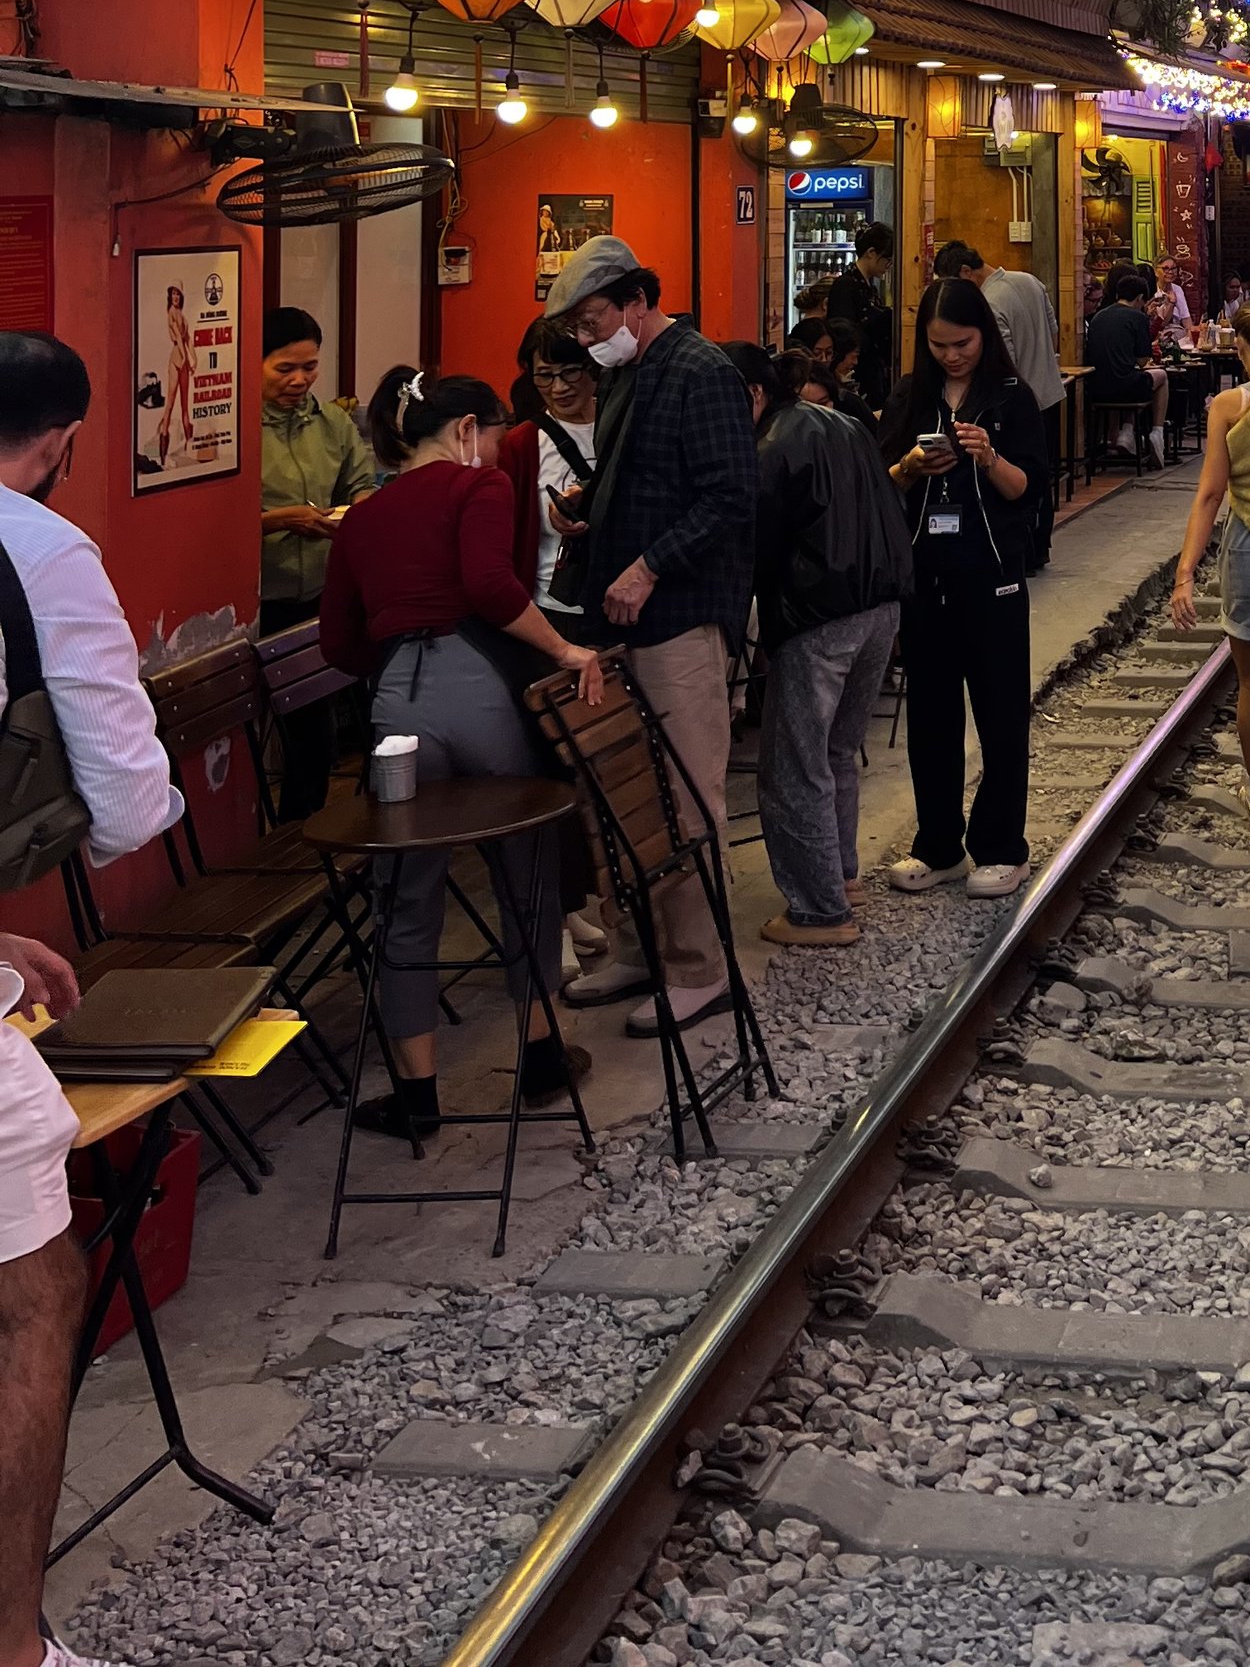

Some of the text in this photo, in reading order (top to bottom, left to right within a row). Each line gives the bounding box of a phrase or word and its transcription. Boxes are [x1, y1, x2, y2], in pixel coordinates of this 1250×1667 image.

[814, 174, 863, 192] pepsi
[739, 190, 752, 218] 72
[194, 371, 232, 388] VIETNAM
[193, 402, 232, 419] HISTORY
